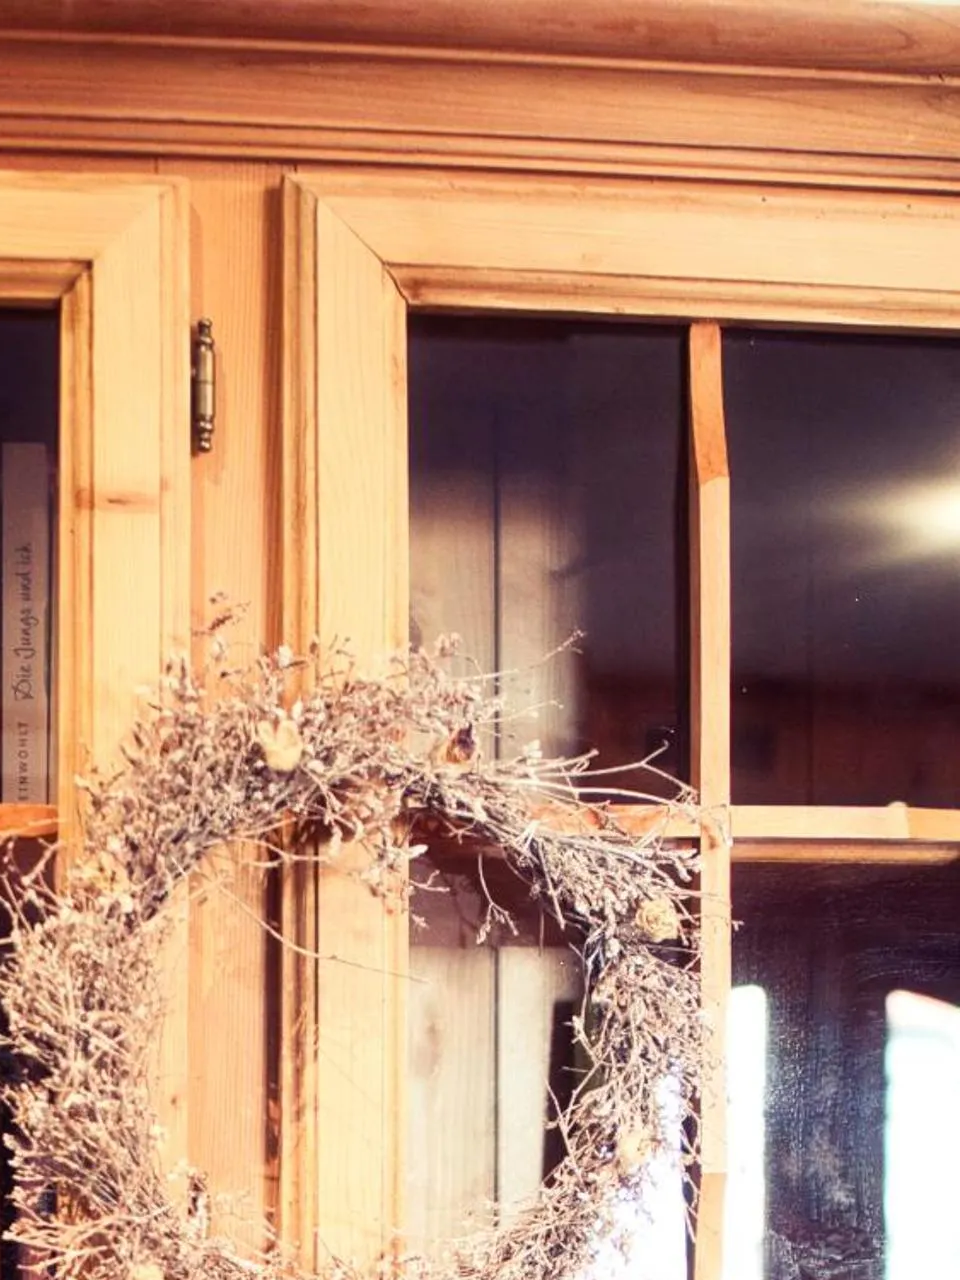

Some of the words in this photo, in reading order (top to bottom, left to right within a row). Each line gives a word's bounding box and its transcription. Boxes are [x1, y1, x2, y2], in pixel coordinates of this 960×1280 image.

[13, 541, 32, 566] ich
[13, 571, 32, 602] und
[11, 607, 40, 660] Jungs
[10, 665, 36, 702] Die
